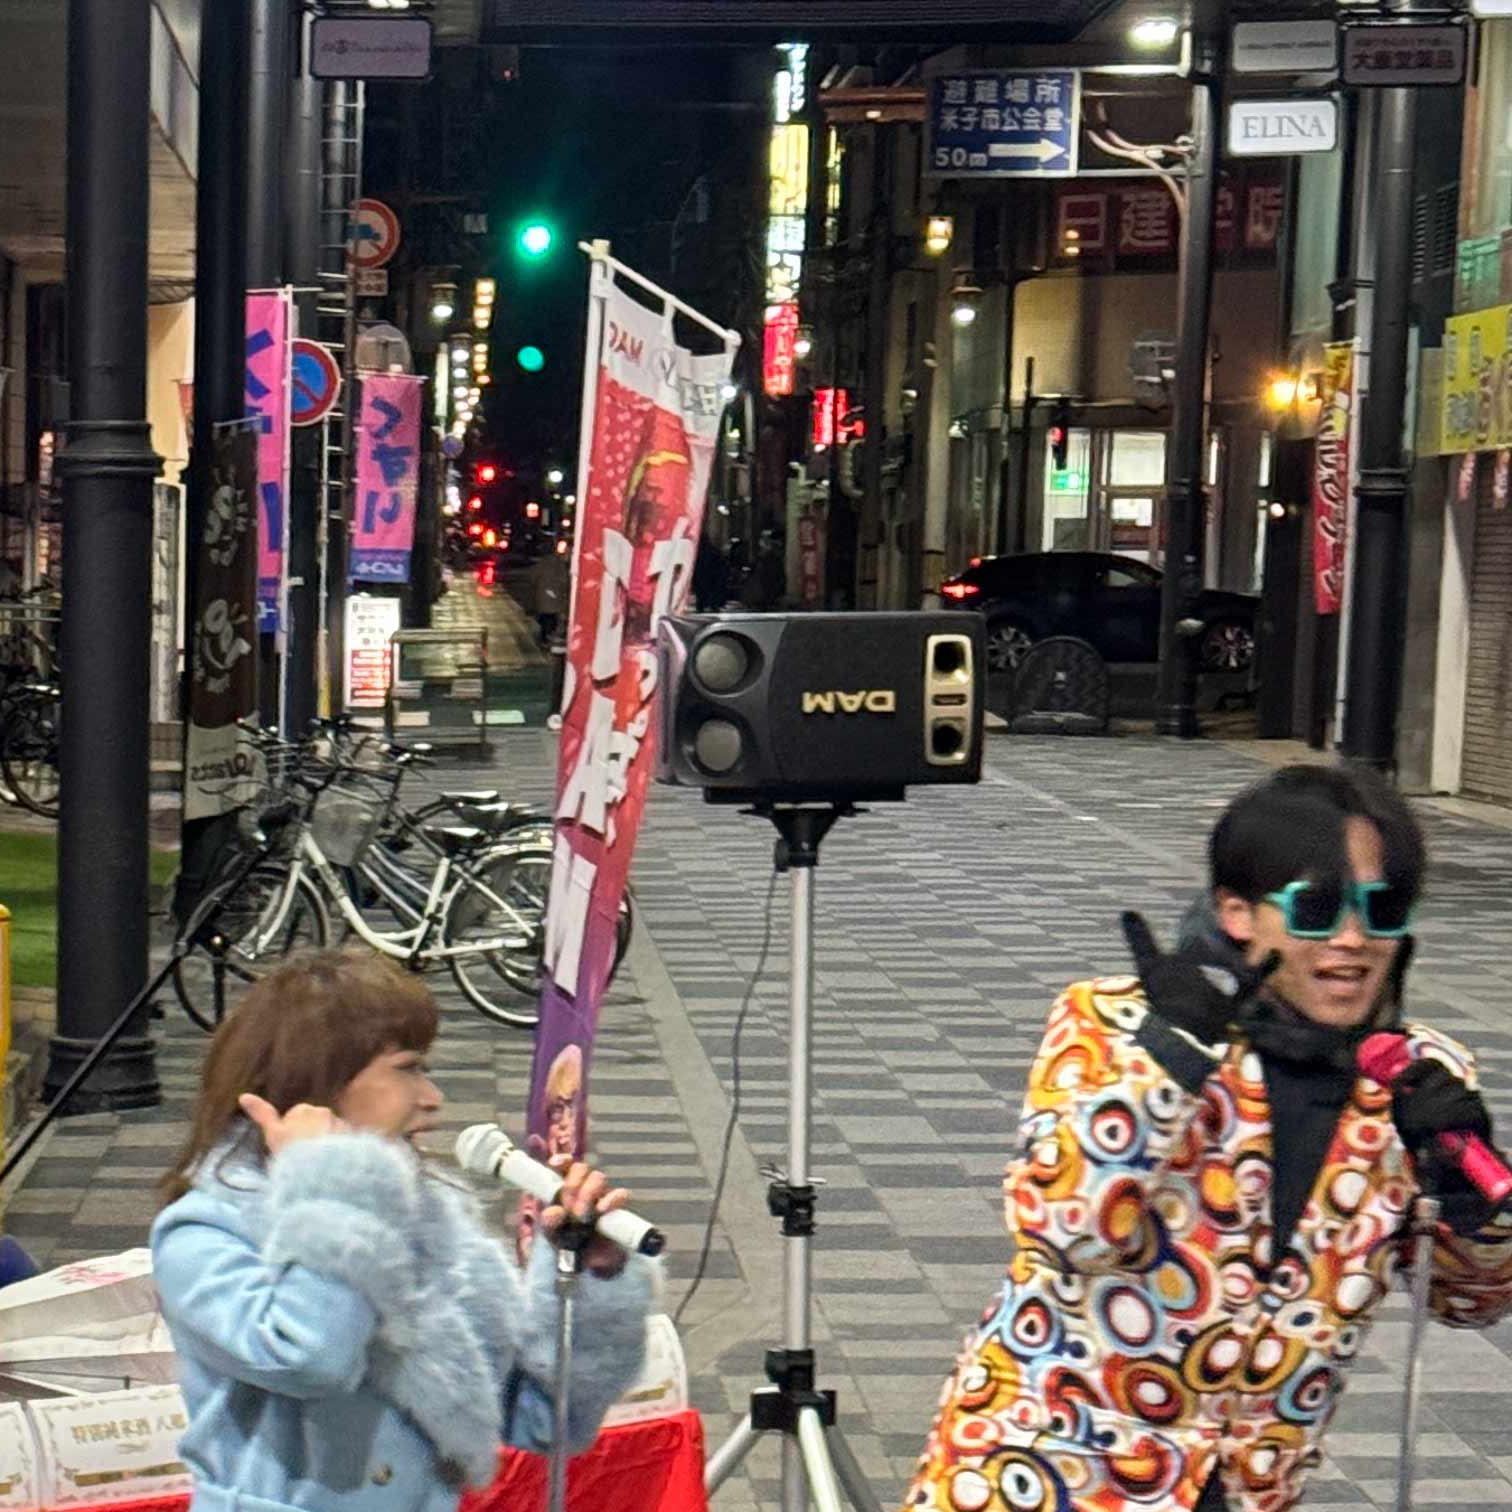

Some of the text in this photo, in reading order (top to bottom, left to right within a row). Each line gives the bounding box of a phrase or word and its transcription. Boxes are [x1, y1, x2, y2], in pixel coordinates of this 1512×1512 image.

[943, 78, 1062, 103] 避難場所
[940, 106, 1064, 131] 米子市公会堂
[1242, 114, 1327, 139] ELINA
[801, 690, 896, 714] DAM
